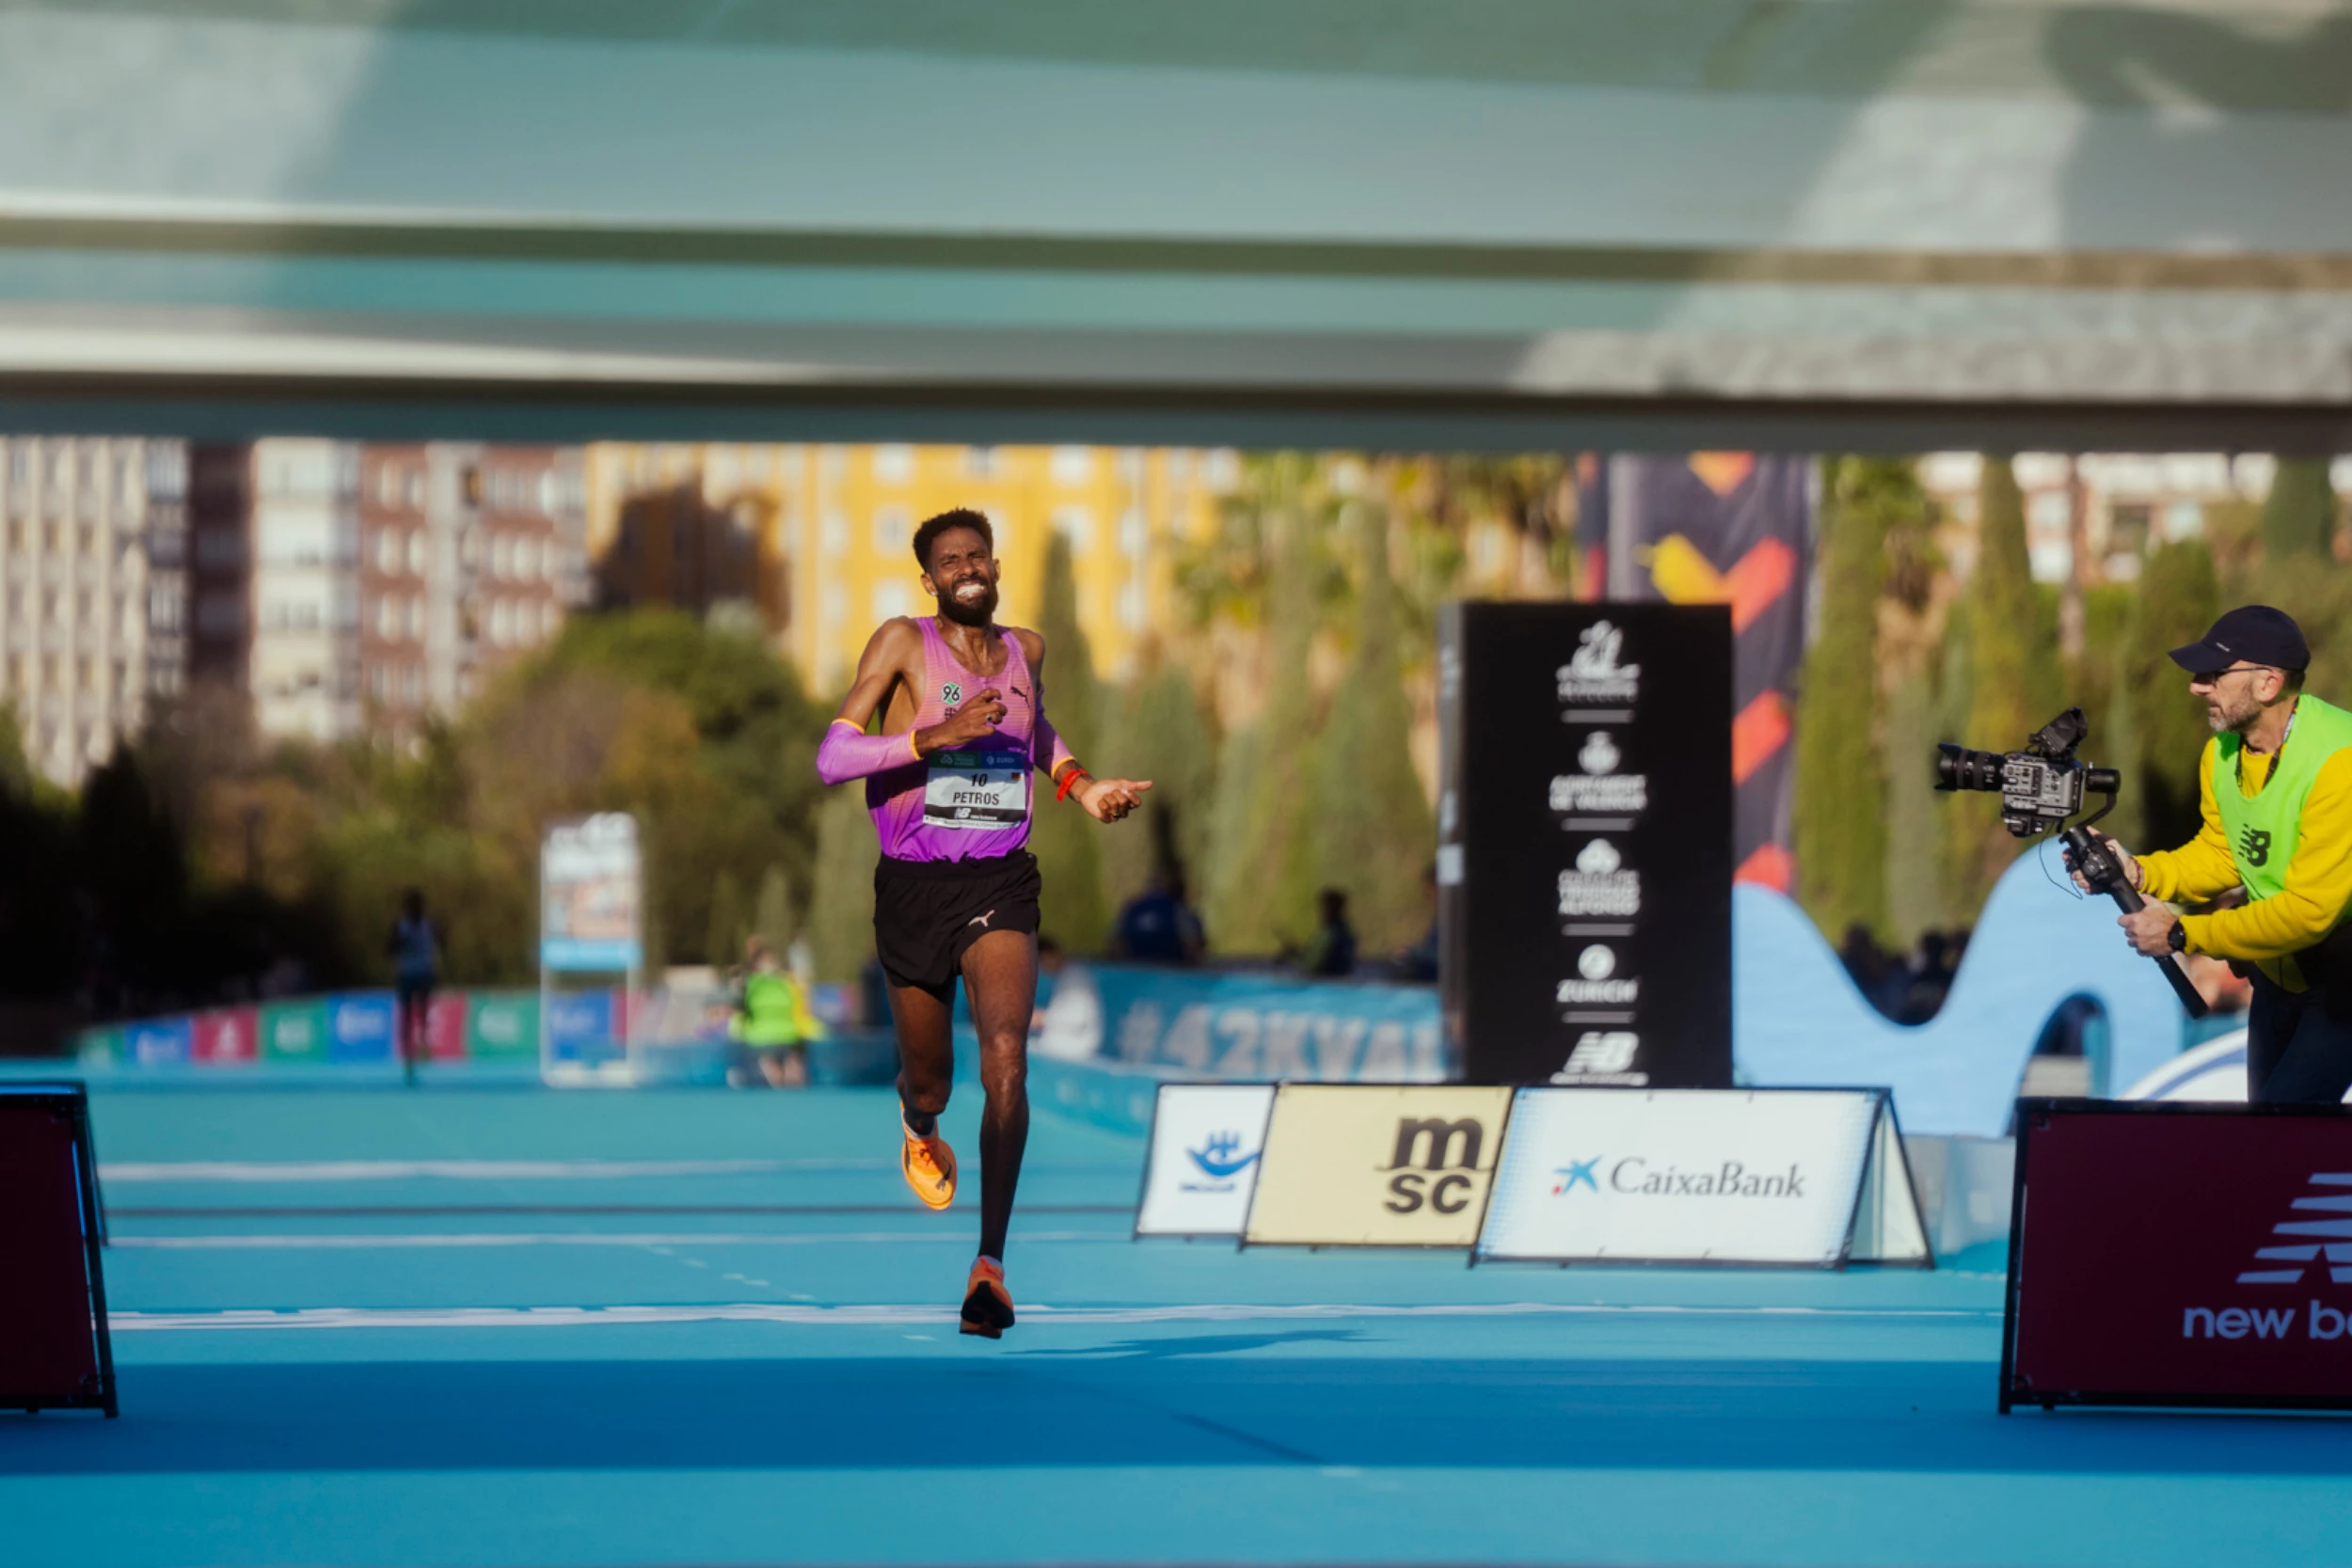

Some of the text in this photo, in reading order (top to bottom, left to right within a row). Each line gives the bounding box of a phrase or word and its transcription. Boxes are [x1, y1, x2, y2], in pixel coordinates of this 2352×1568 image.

[943, 685, 960, 702] 96
[970, 773, 988, 787] 10
[952, 791, 1000, 806] PETROS
[1610, 1156, 1805, 1199] CaixaBank
[2183, 1307, 2296, 1339] new
